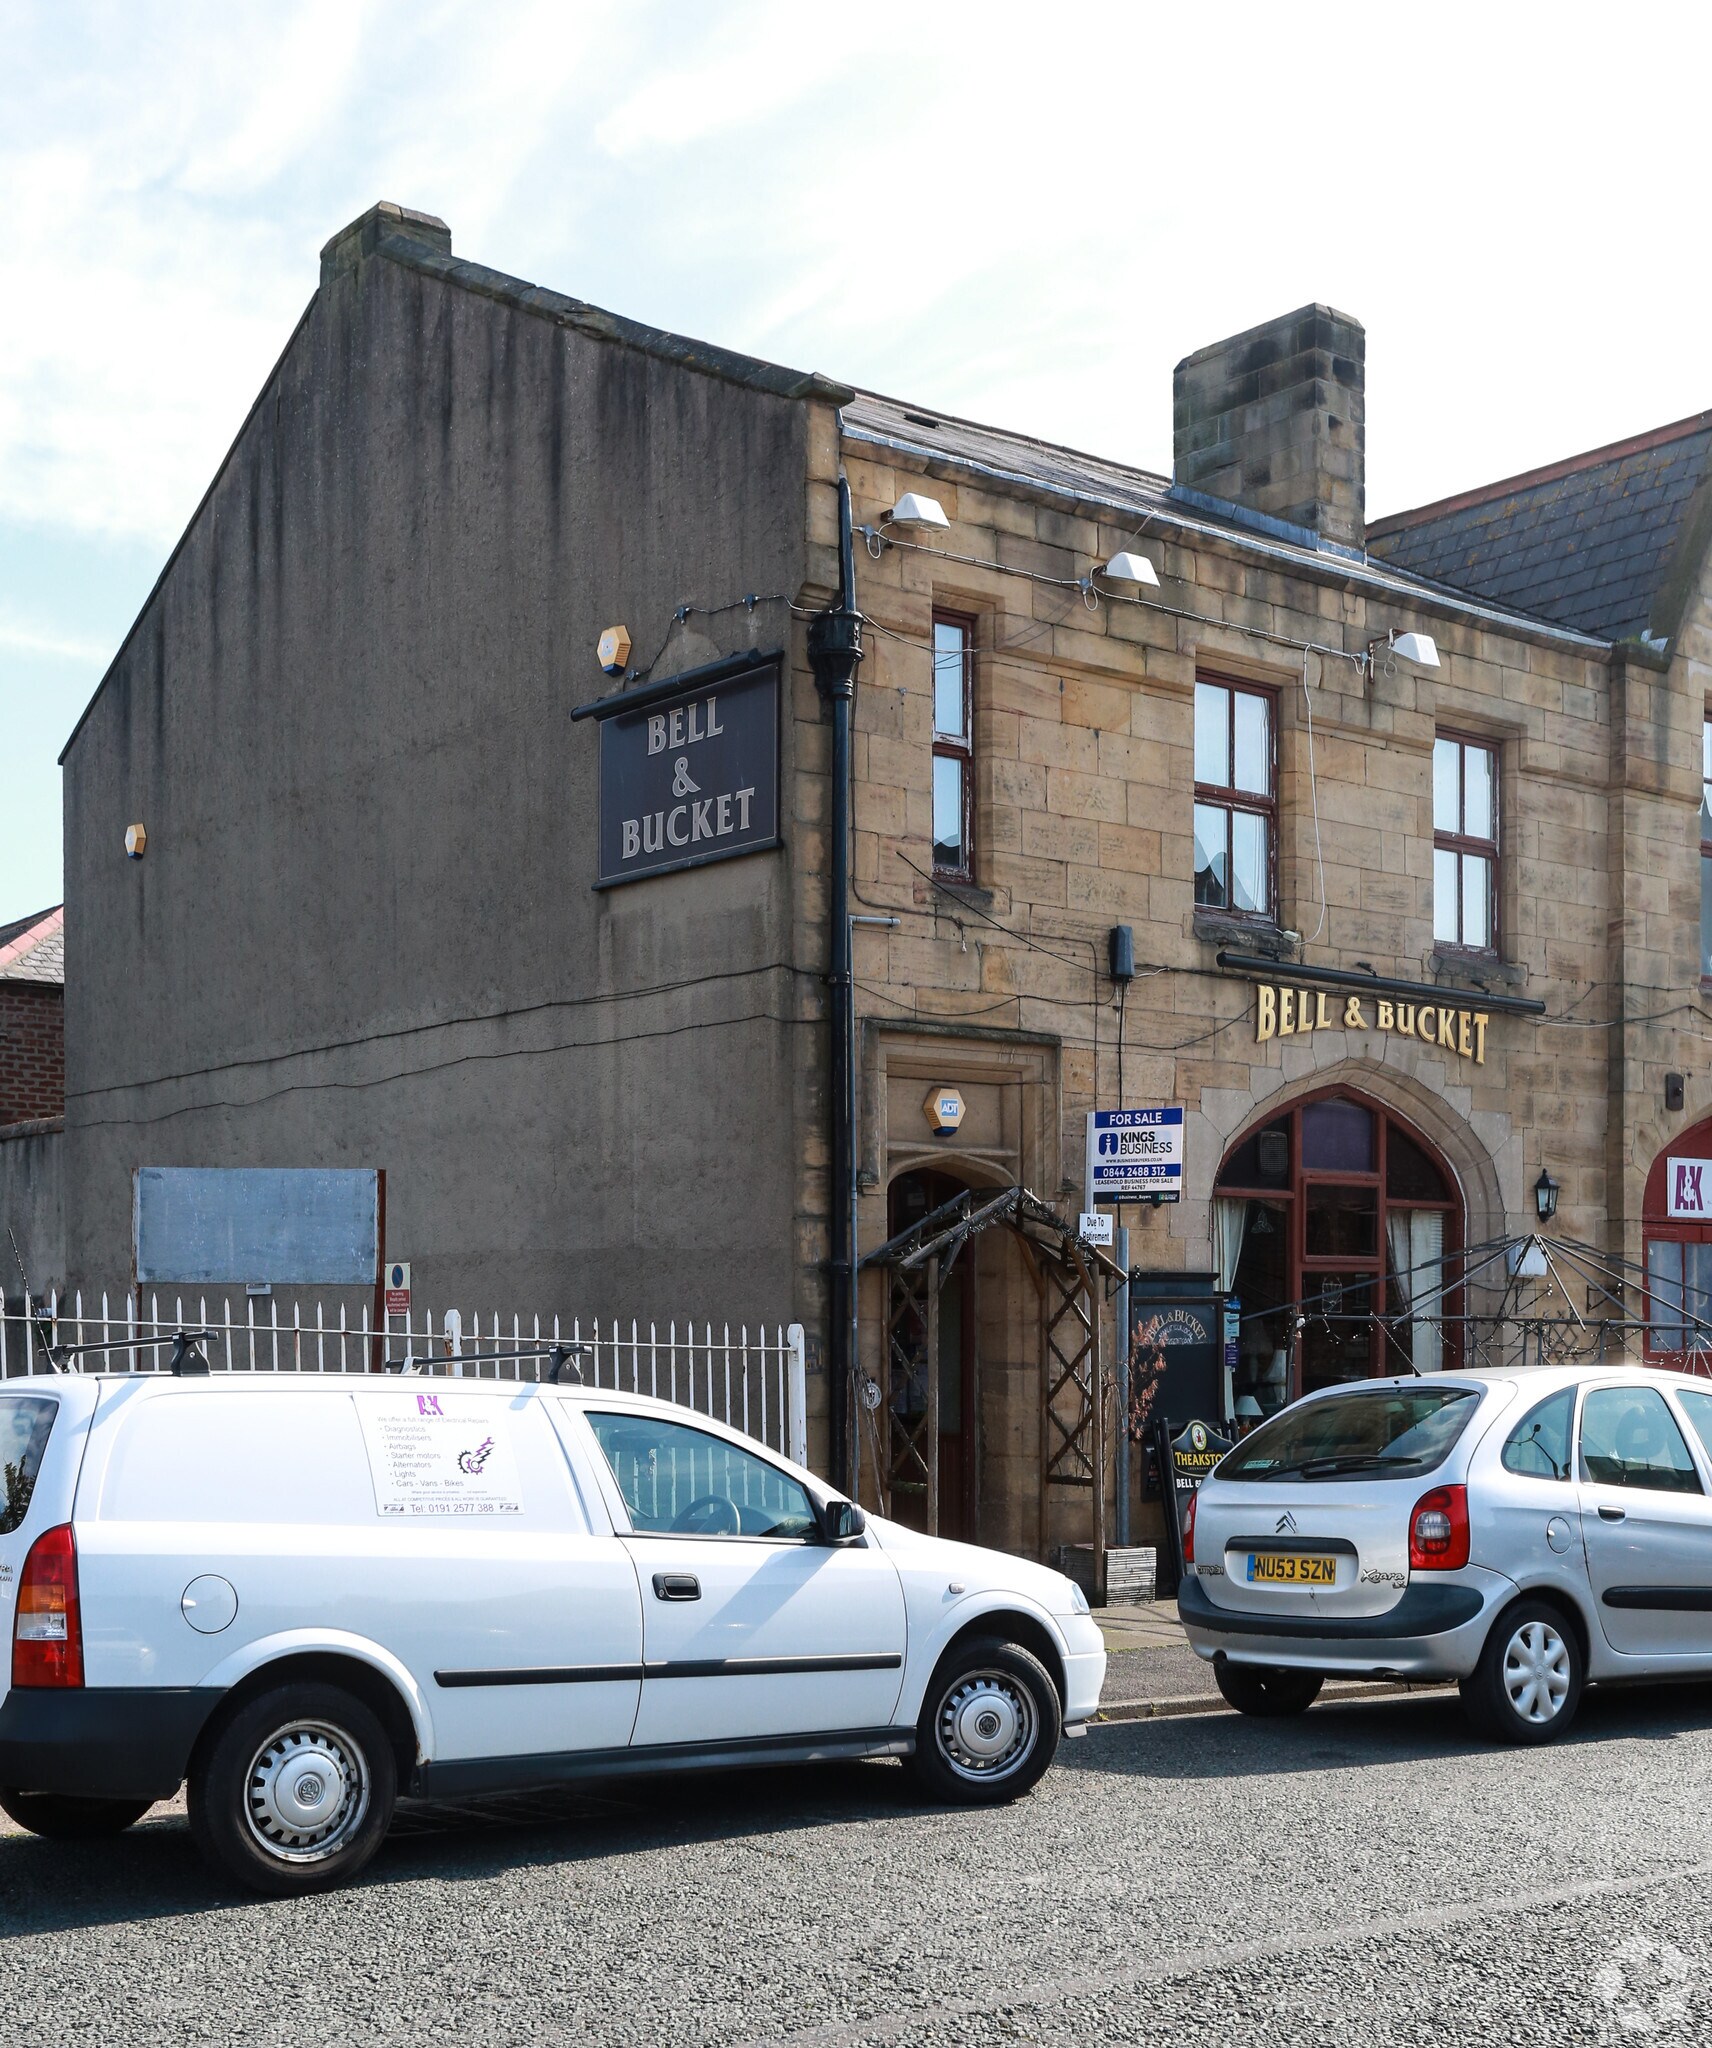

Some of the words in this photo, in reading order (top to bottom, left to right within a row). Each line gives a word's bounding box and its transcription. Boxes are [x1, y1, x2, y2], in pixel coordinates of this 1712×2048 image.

[648, 697, 723, 755] BELL
[672, 757, 701, 797] &
[622, 787, 755, 859] BUCKET
[1256, 984, 1332, 1044] BELL
[1343, 997, 1369, 1030] &
[1376, 1000, 1489, 1065] BUCKET
[941, 1102, 958, 1113] ADT
[1110, 1114, 1132, 1125] FOR
[1134, 1112, 1162, 1124] SALE
[1120, 1131, 1155, 1143] KINGS
[1120, 1141, 1172, 1155] BUSINESS
[1103, 1168, 1125, 1177] 0844
[1127, 1167, 1149, 1176] 2488
[1151, 1166, 1166, 1176] 312
[1087, 1216, 1097, 1227] Due
[1098, 1216, 1104, 1227] To
[1083, 1231, 1109, 1242] Retirement
[1174, 1309, 1207, 1340] BUCKET
[384, 1425, 426, 1434] Diagnostics
[389, 1443, 416, 1451] Airbags
[1175, 1451, 1226, 1466] THEAKSTO
[394, 1470, 416, 1478] Lights
[1176, 1478, 1194, 1488] BELL
[1195, 1480, 1202, 1488] &
[411, 1504, 426, 1513] Tel:
[428, 1504, 450, 1513] 0191
[453, 1503, 474, 1512] 2577
[478, 1503, 494, 1512] 388
[1257, 1558, 1295, 1578] NU53
[1300, 1560, 1334, 1580] SZN
